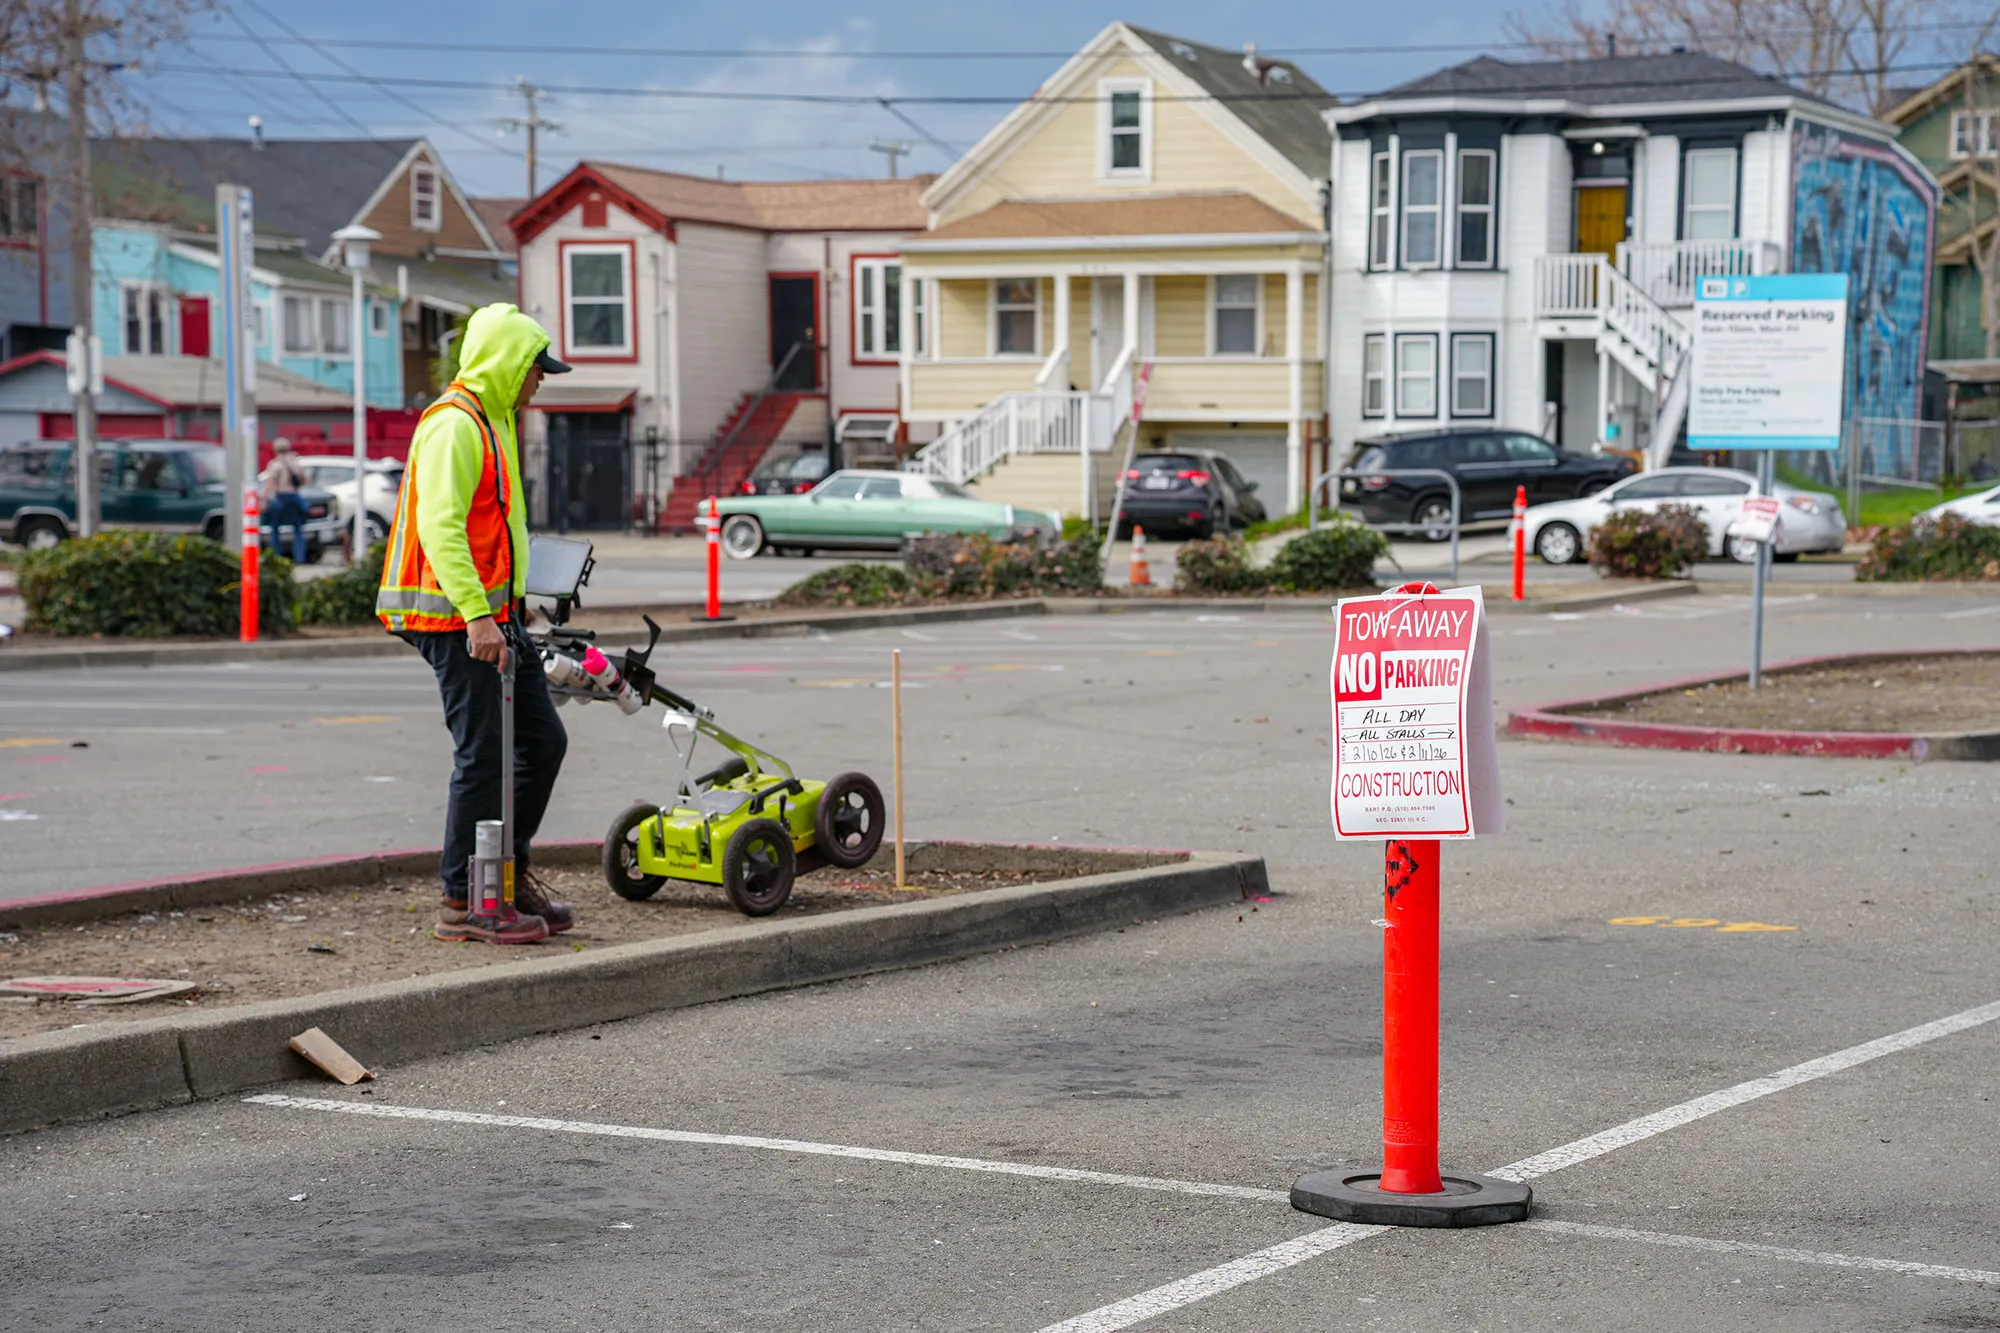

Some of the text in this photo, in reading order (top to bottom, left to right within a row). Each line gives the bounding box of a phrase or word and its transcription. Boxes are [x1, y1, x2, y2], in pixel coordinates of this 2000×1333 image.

[1702, 308, 1835, 324] Reserved Parking
[1745, 385, 1781, 397] Parking
[1345, 610, 1468, 641] TOW-AWAY
[1339, 652, 1460, 693] NO PARKING
[1362, 708, 1426, 724] ALL DAY
[1359, 728, 1425, 740] ALL STALLS
[1341, 770, 1460, 798] CONSTRUCTION
